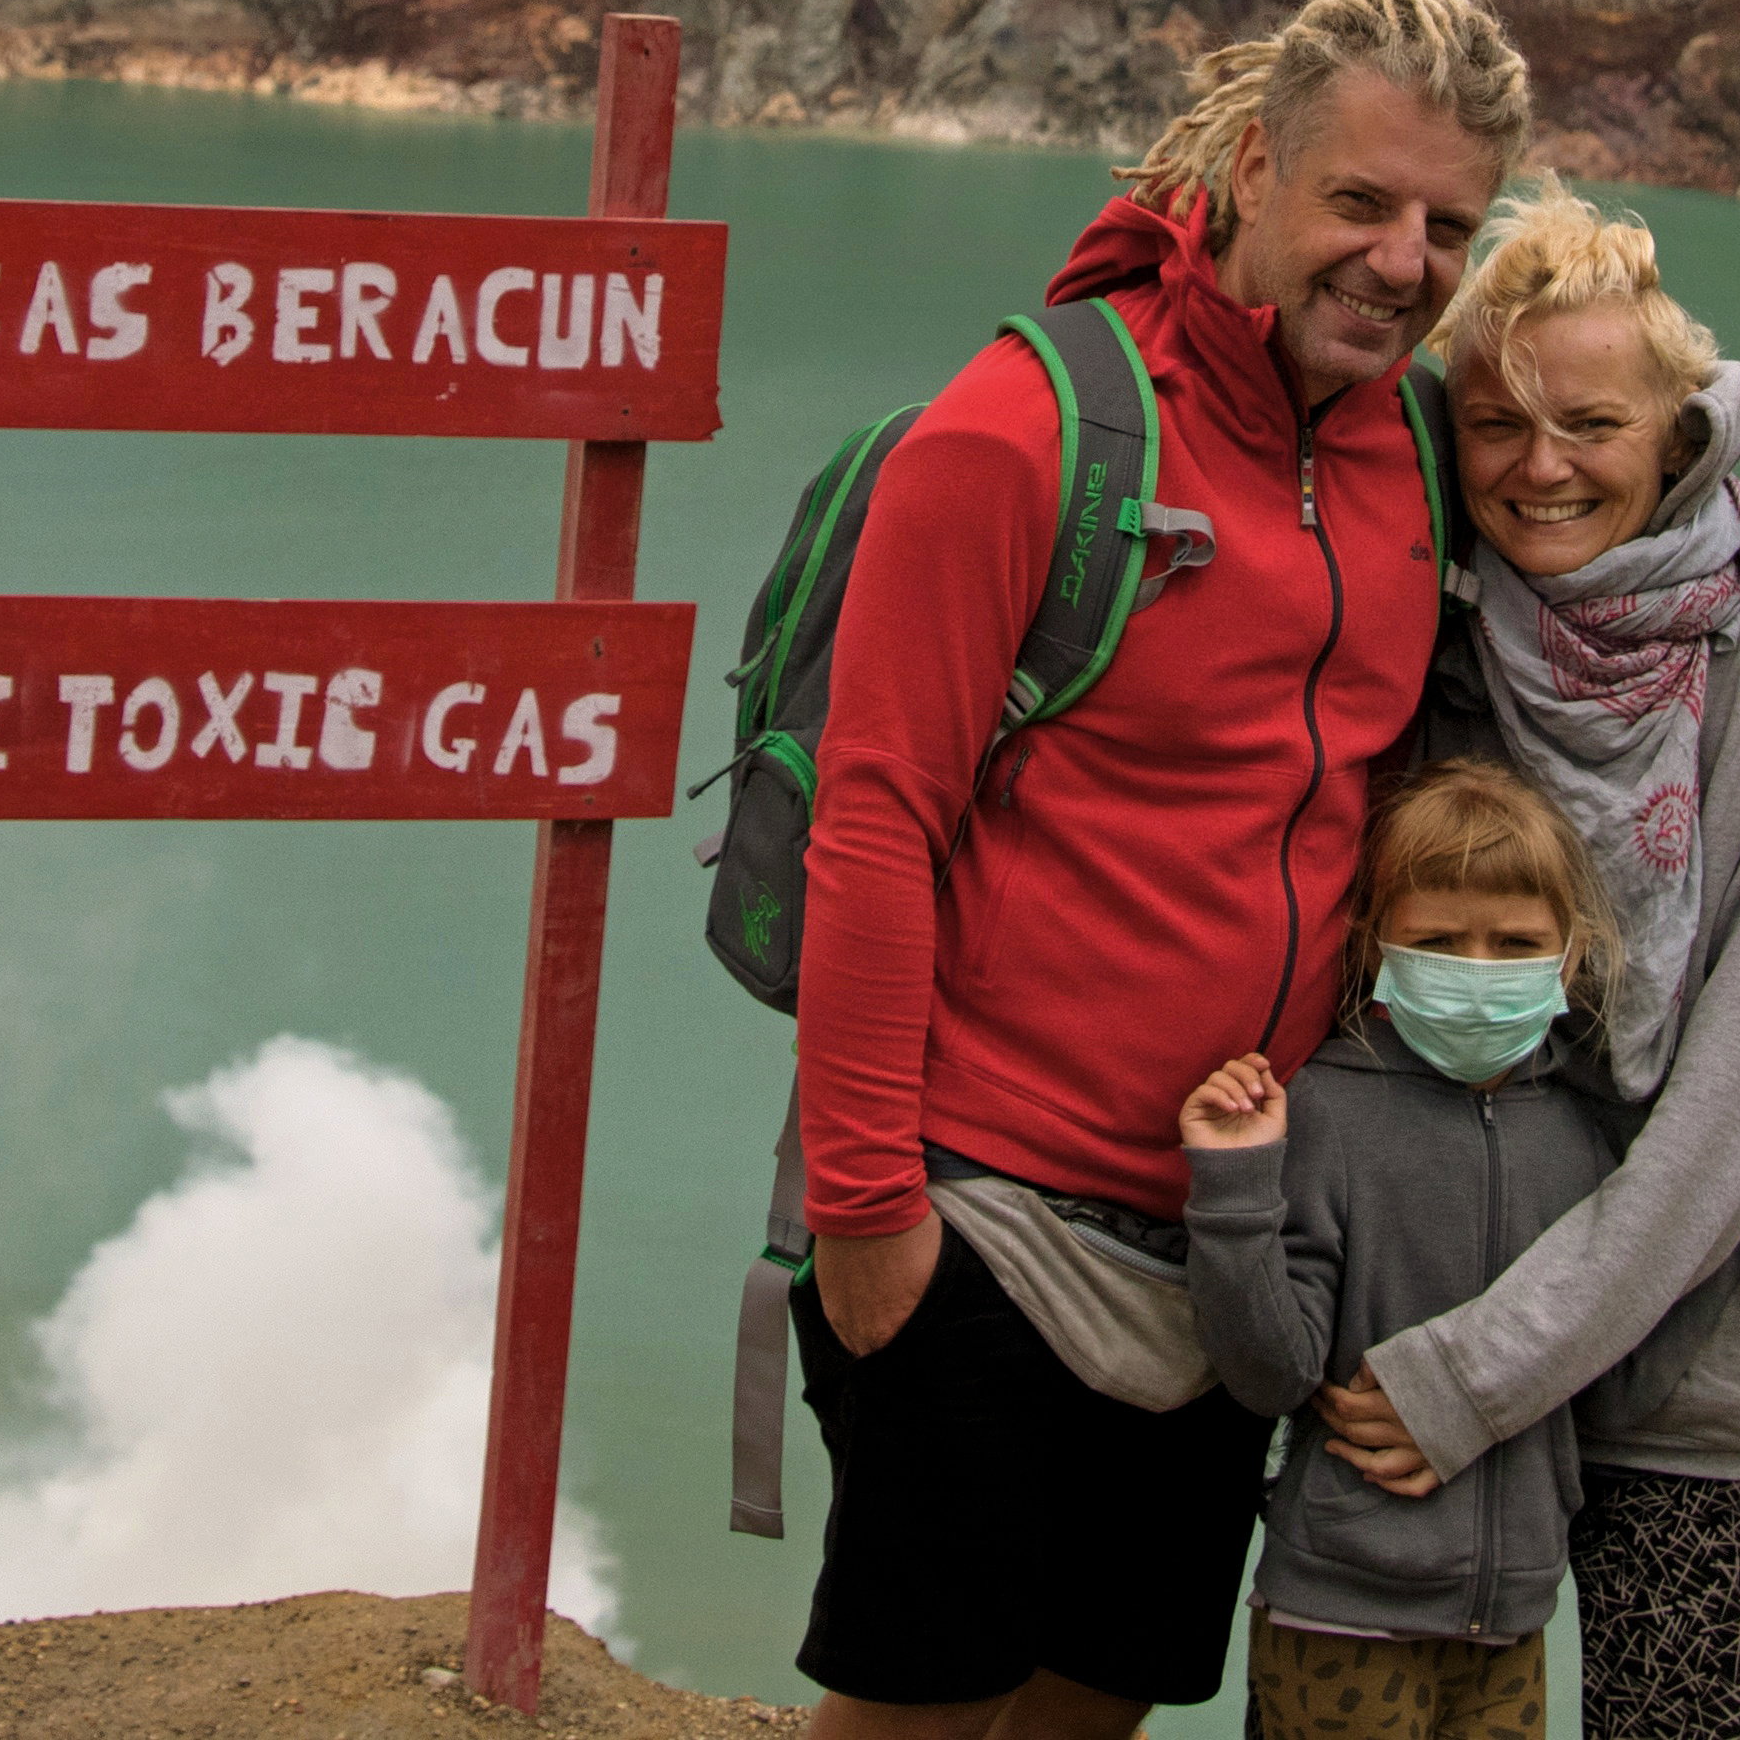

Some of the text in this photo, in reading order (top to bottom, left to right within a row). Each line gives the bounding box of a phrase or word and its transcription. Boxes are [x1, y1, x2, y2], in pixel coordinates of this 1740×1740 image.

[201, 261, 665, 370] BERACUN
[1060, 459, 1109, 612] DAKINE
[59, 667, 383, 773] TOXIC
[422, 679, 622, 785] GAS
